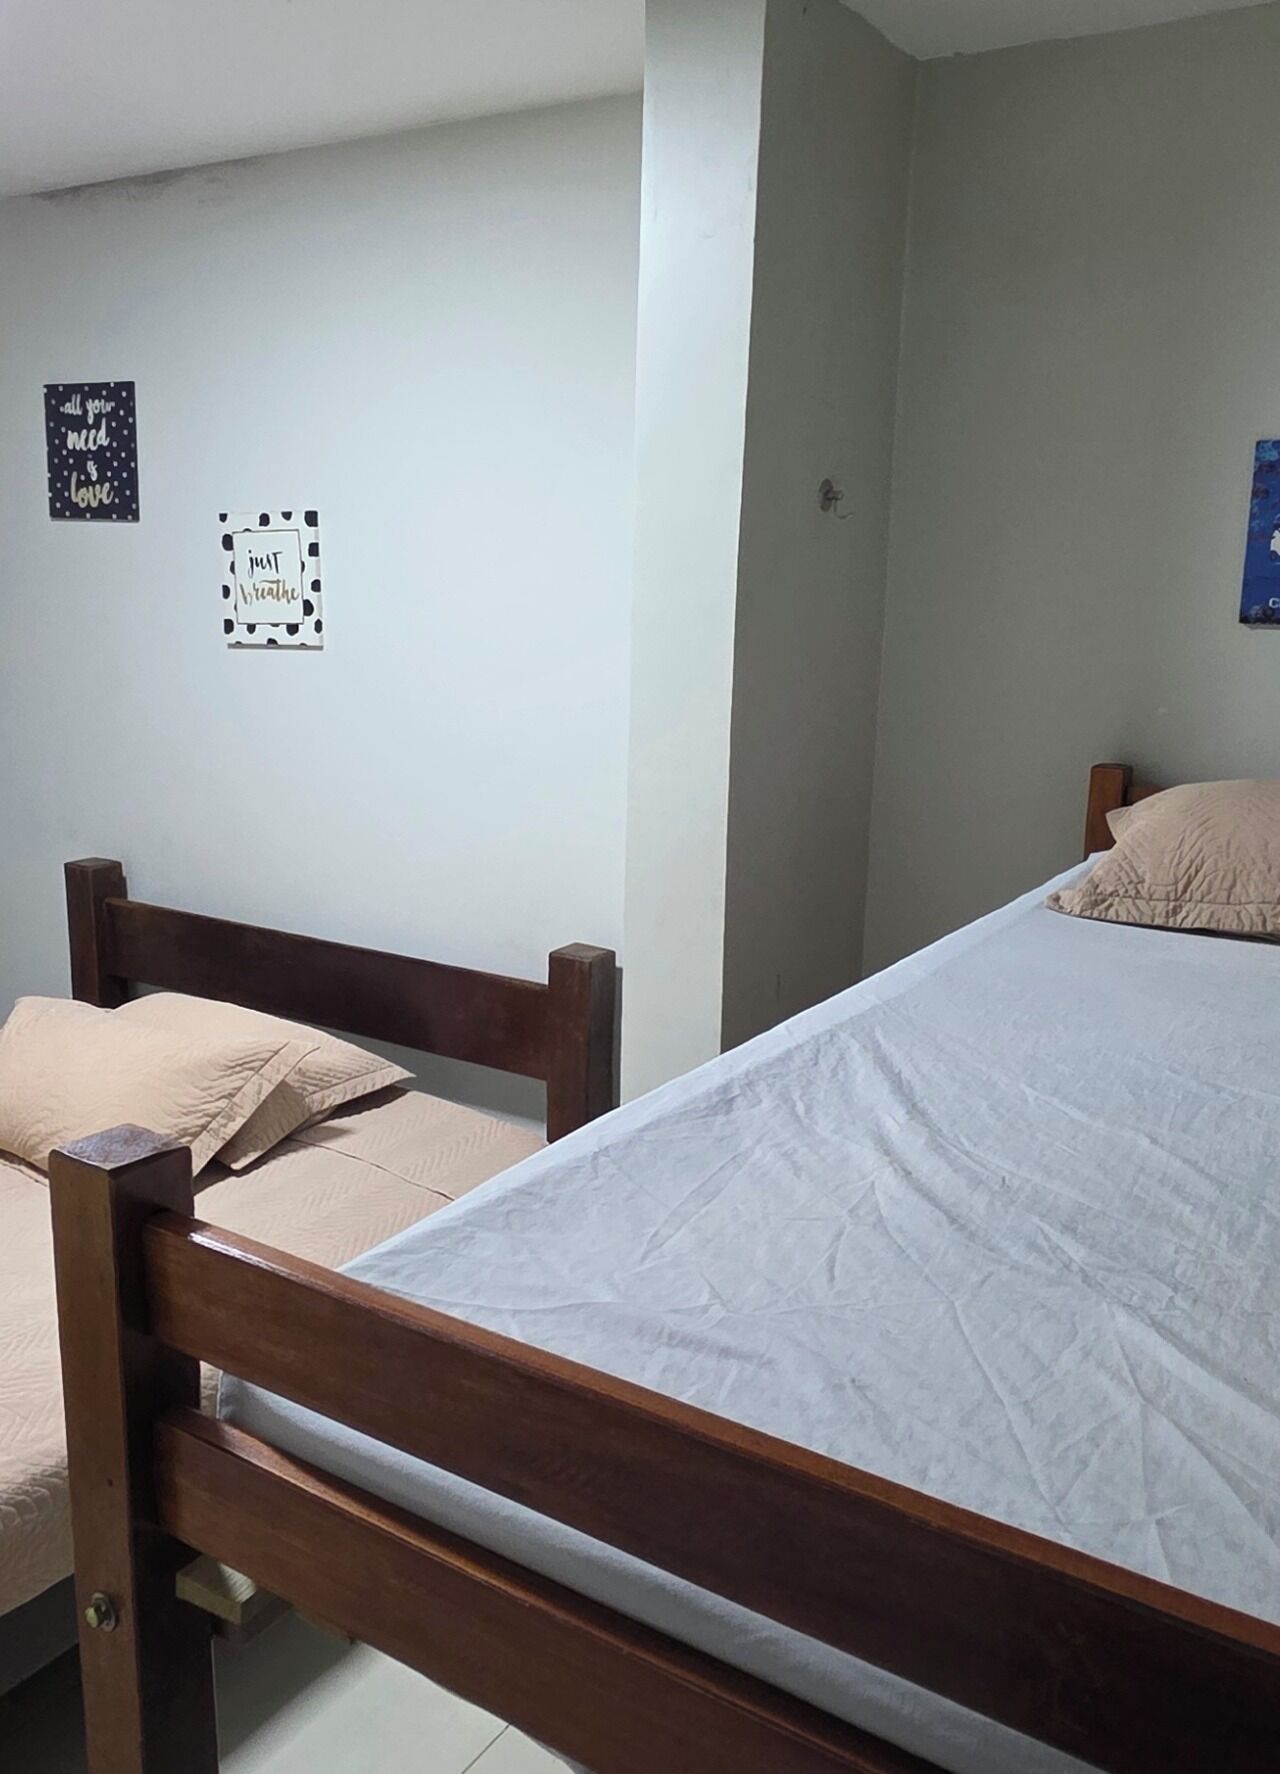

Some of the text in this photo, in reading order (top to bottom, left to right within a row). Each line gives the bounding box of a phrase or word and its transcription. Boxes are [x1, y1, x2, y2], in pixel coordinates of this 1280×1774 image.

[63, 393, 112, 425] all you
[66, 417, 110, 451] need
[86, 460, 98, 481] is
[70, 471, 114, 508] love
[239, 579, 300, 606] breathe
